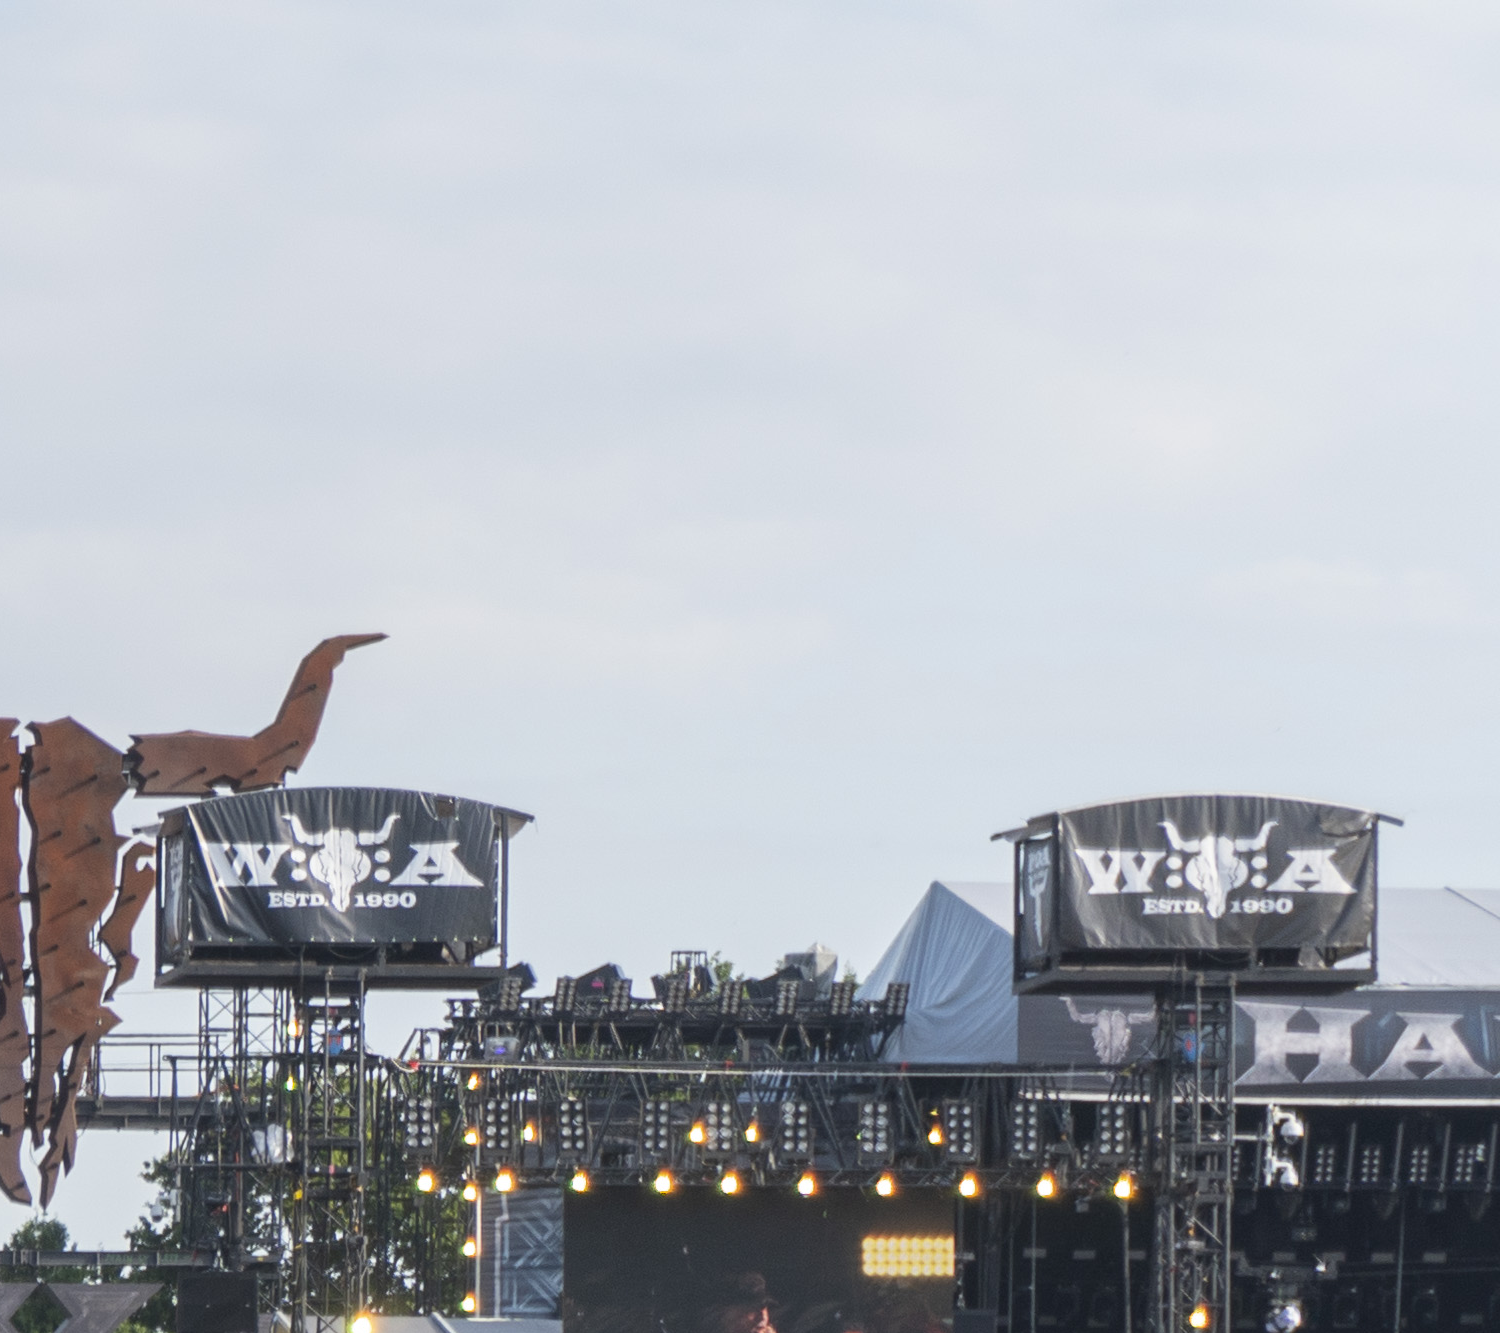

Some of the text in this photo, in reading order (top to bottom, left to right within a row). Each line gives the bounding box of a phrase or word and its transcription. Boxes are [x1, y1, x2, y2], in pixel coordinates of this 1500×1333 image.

[354, 891, 417, 909] 1990
[1230, 898, 1294, 915] 1990
[1235, 1001, 1500, 1085] HA
